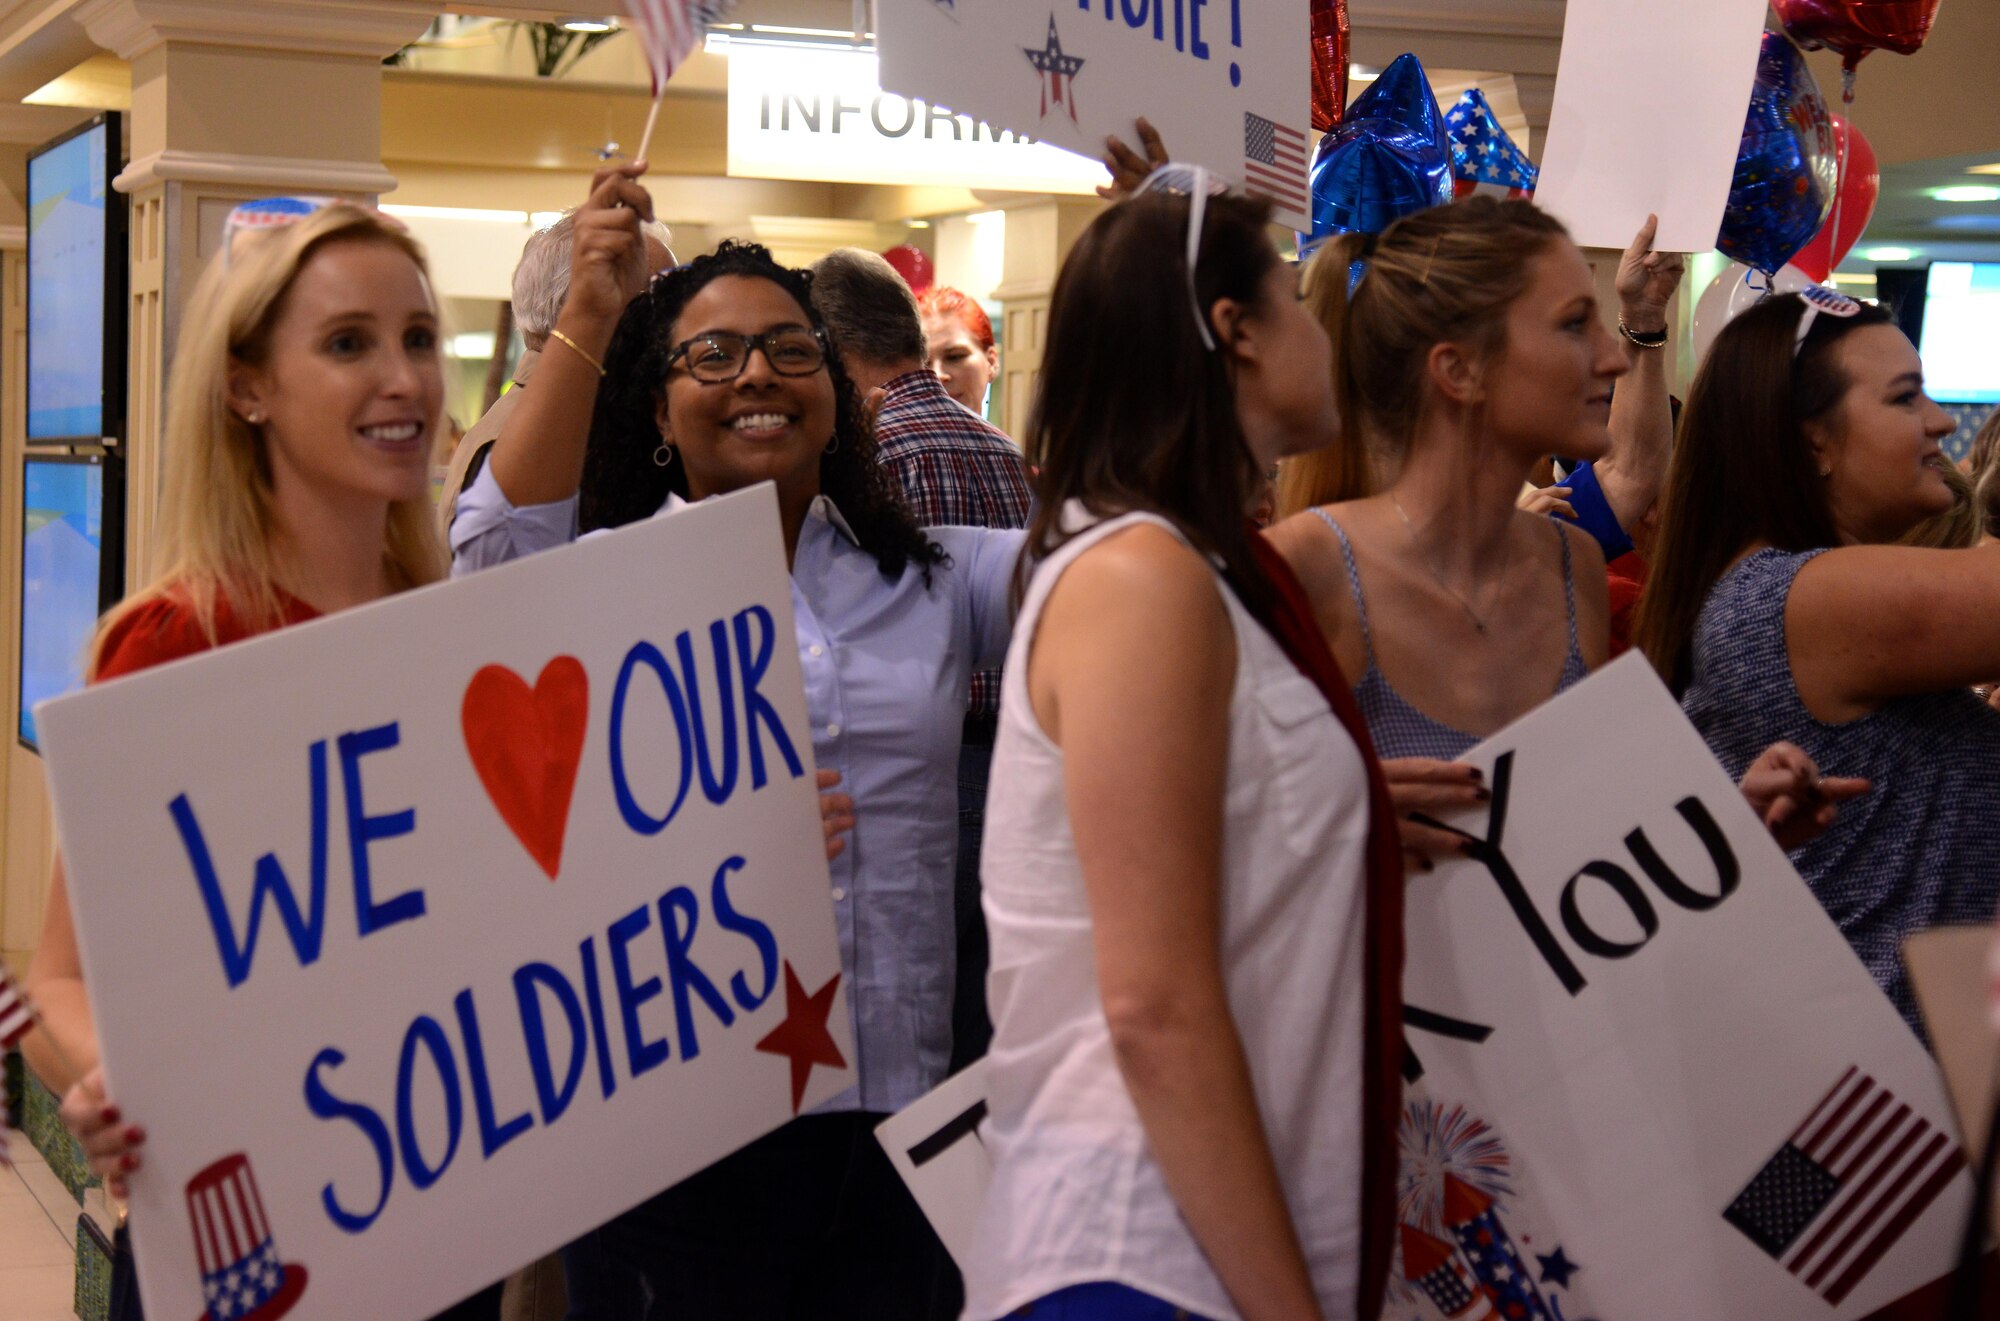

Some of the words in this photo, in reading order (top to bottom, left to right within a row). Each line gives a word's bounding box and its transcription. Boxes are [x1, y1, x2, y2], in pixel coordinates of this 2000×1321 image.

[169, 721, 427, 989] WE
[609, 604, 805, 836] OUR
[303, 855, 779, 1235] SOLDIERS
